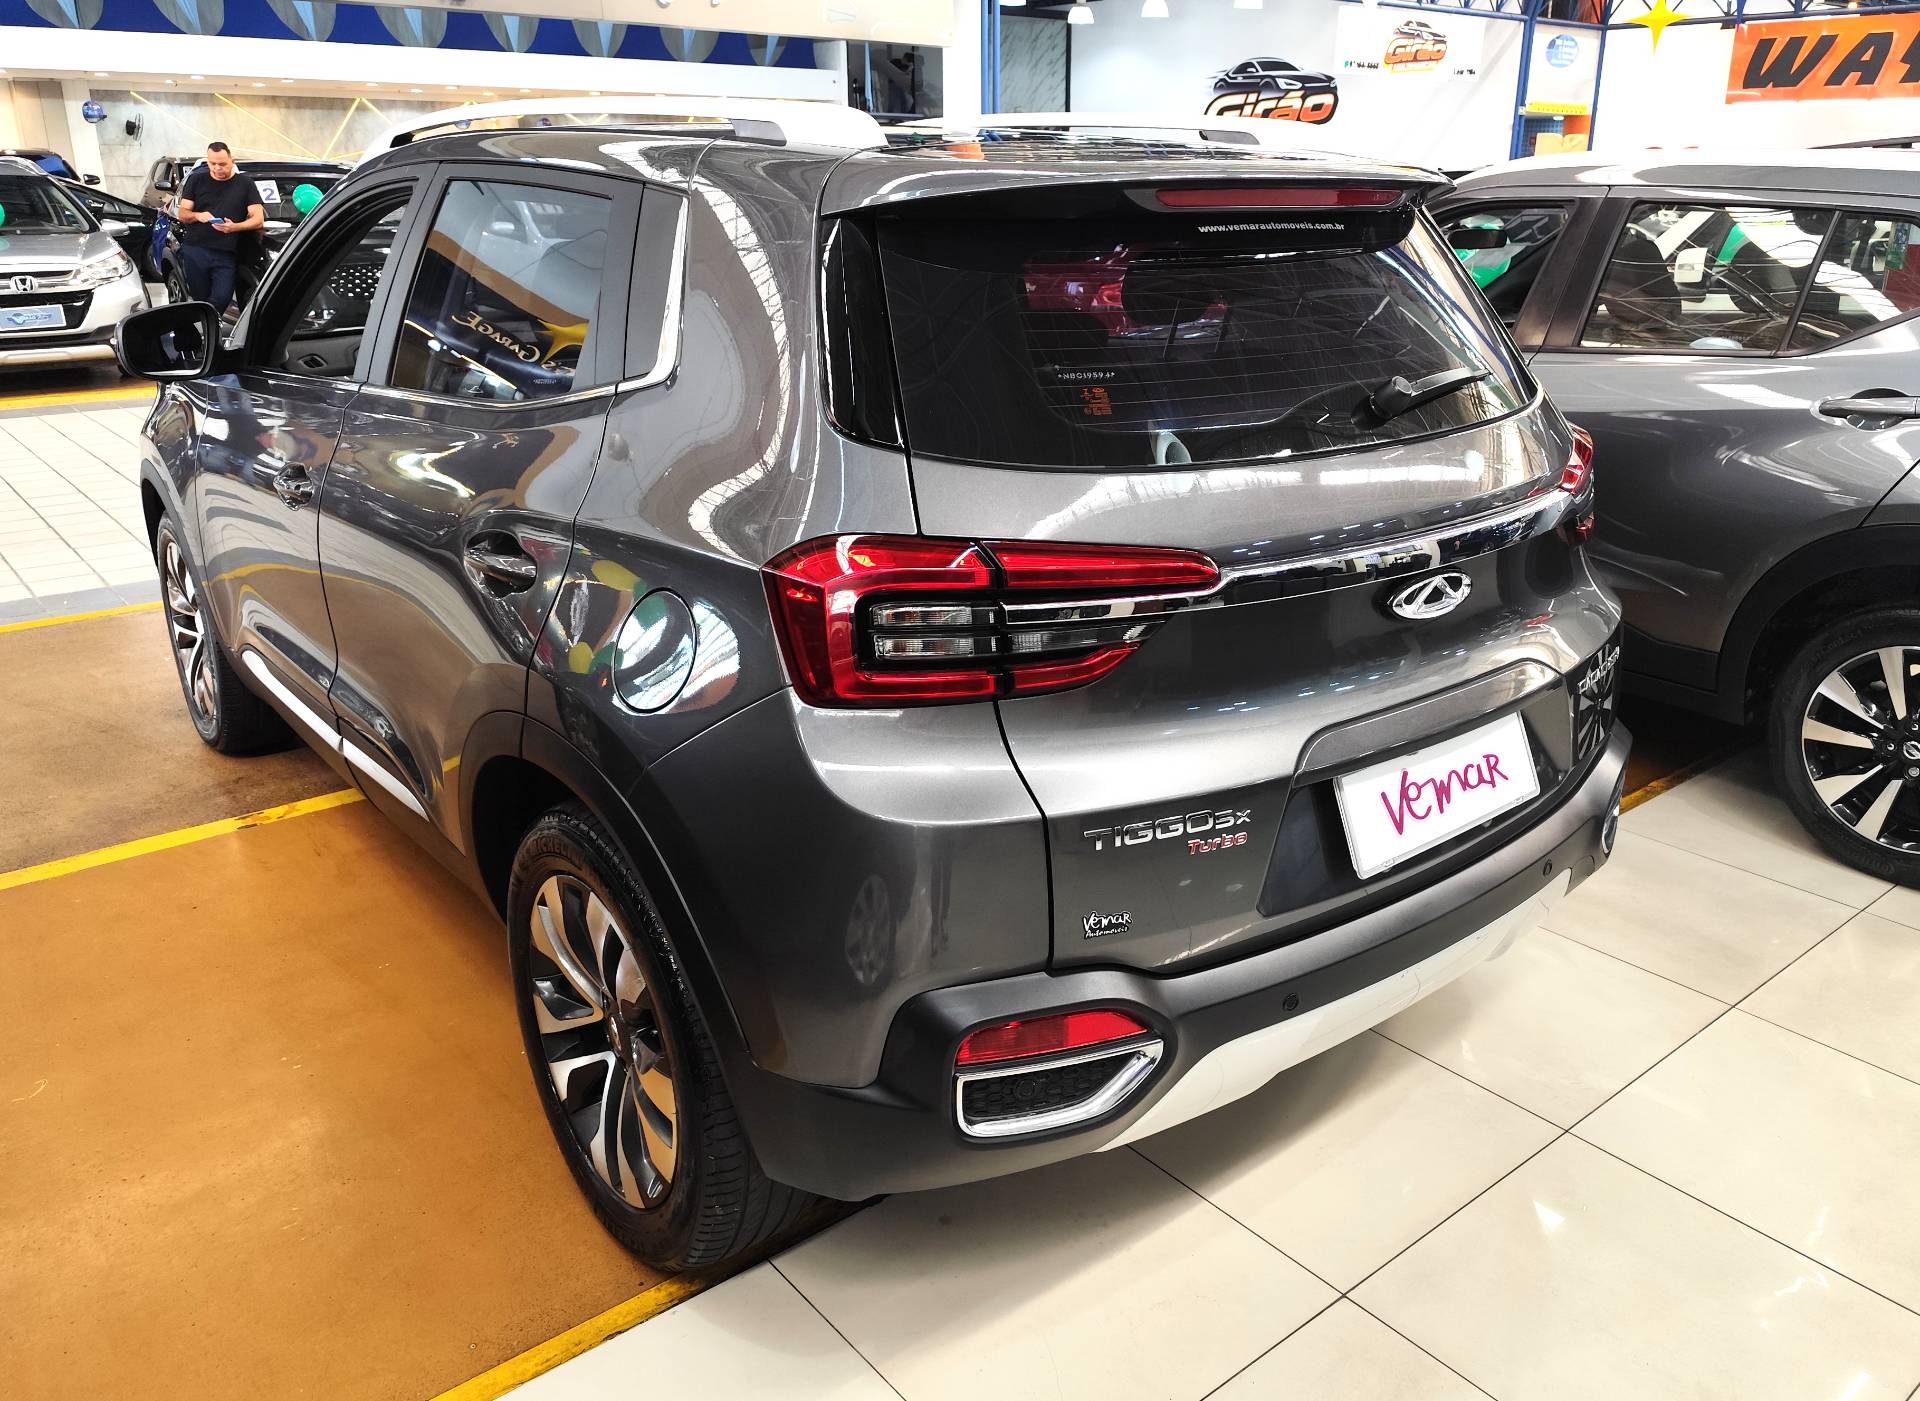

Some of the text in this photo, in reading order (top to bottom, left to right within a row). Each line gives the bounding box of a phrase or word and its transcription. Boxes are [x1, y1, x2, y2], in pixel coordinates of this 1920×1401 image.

[1743, 30, 1920, 89] WA
[262, 187, 277, 201] 2
[1198, 221, 1345, 233] www.vemarautomoveis.com.br
